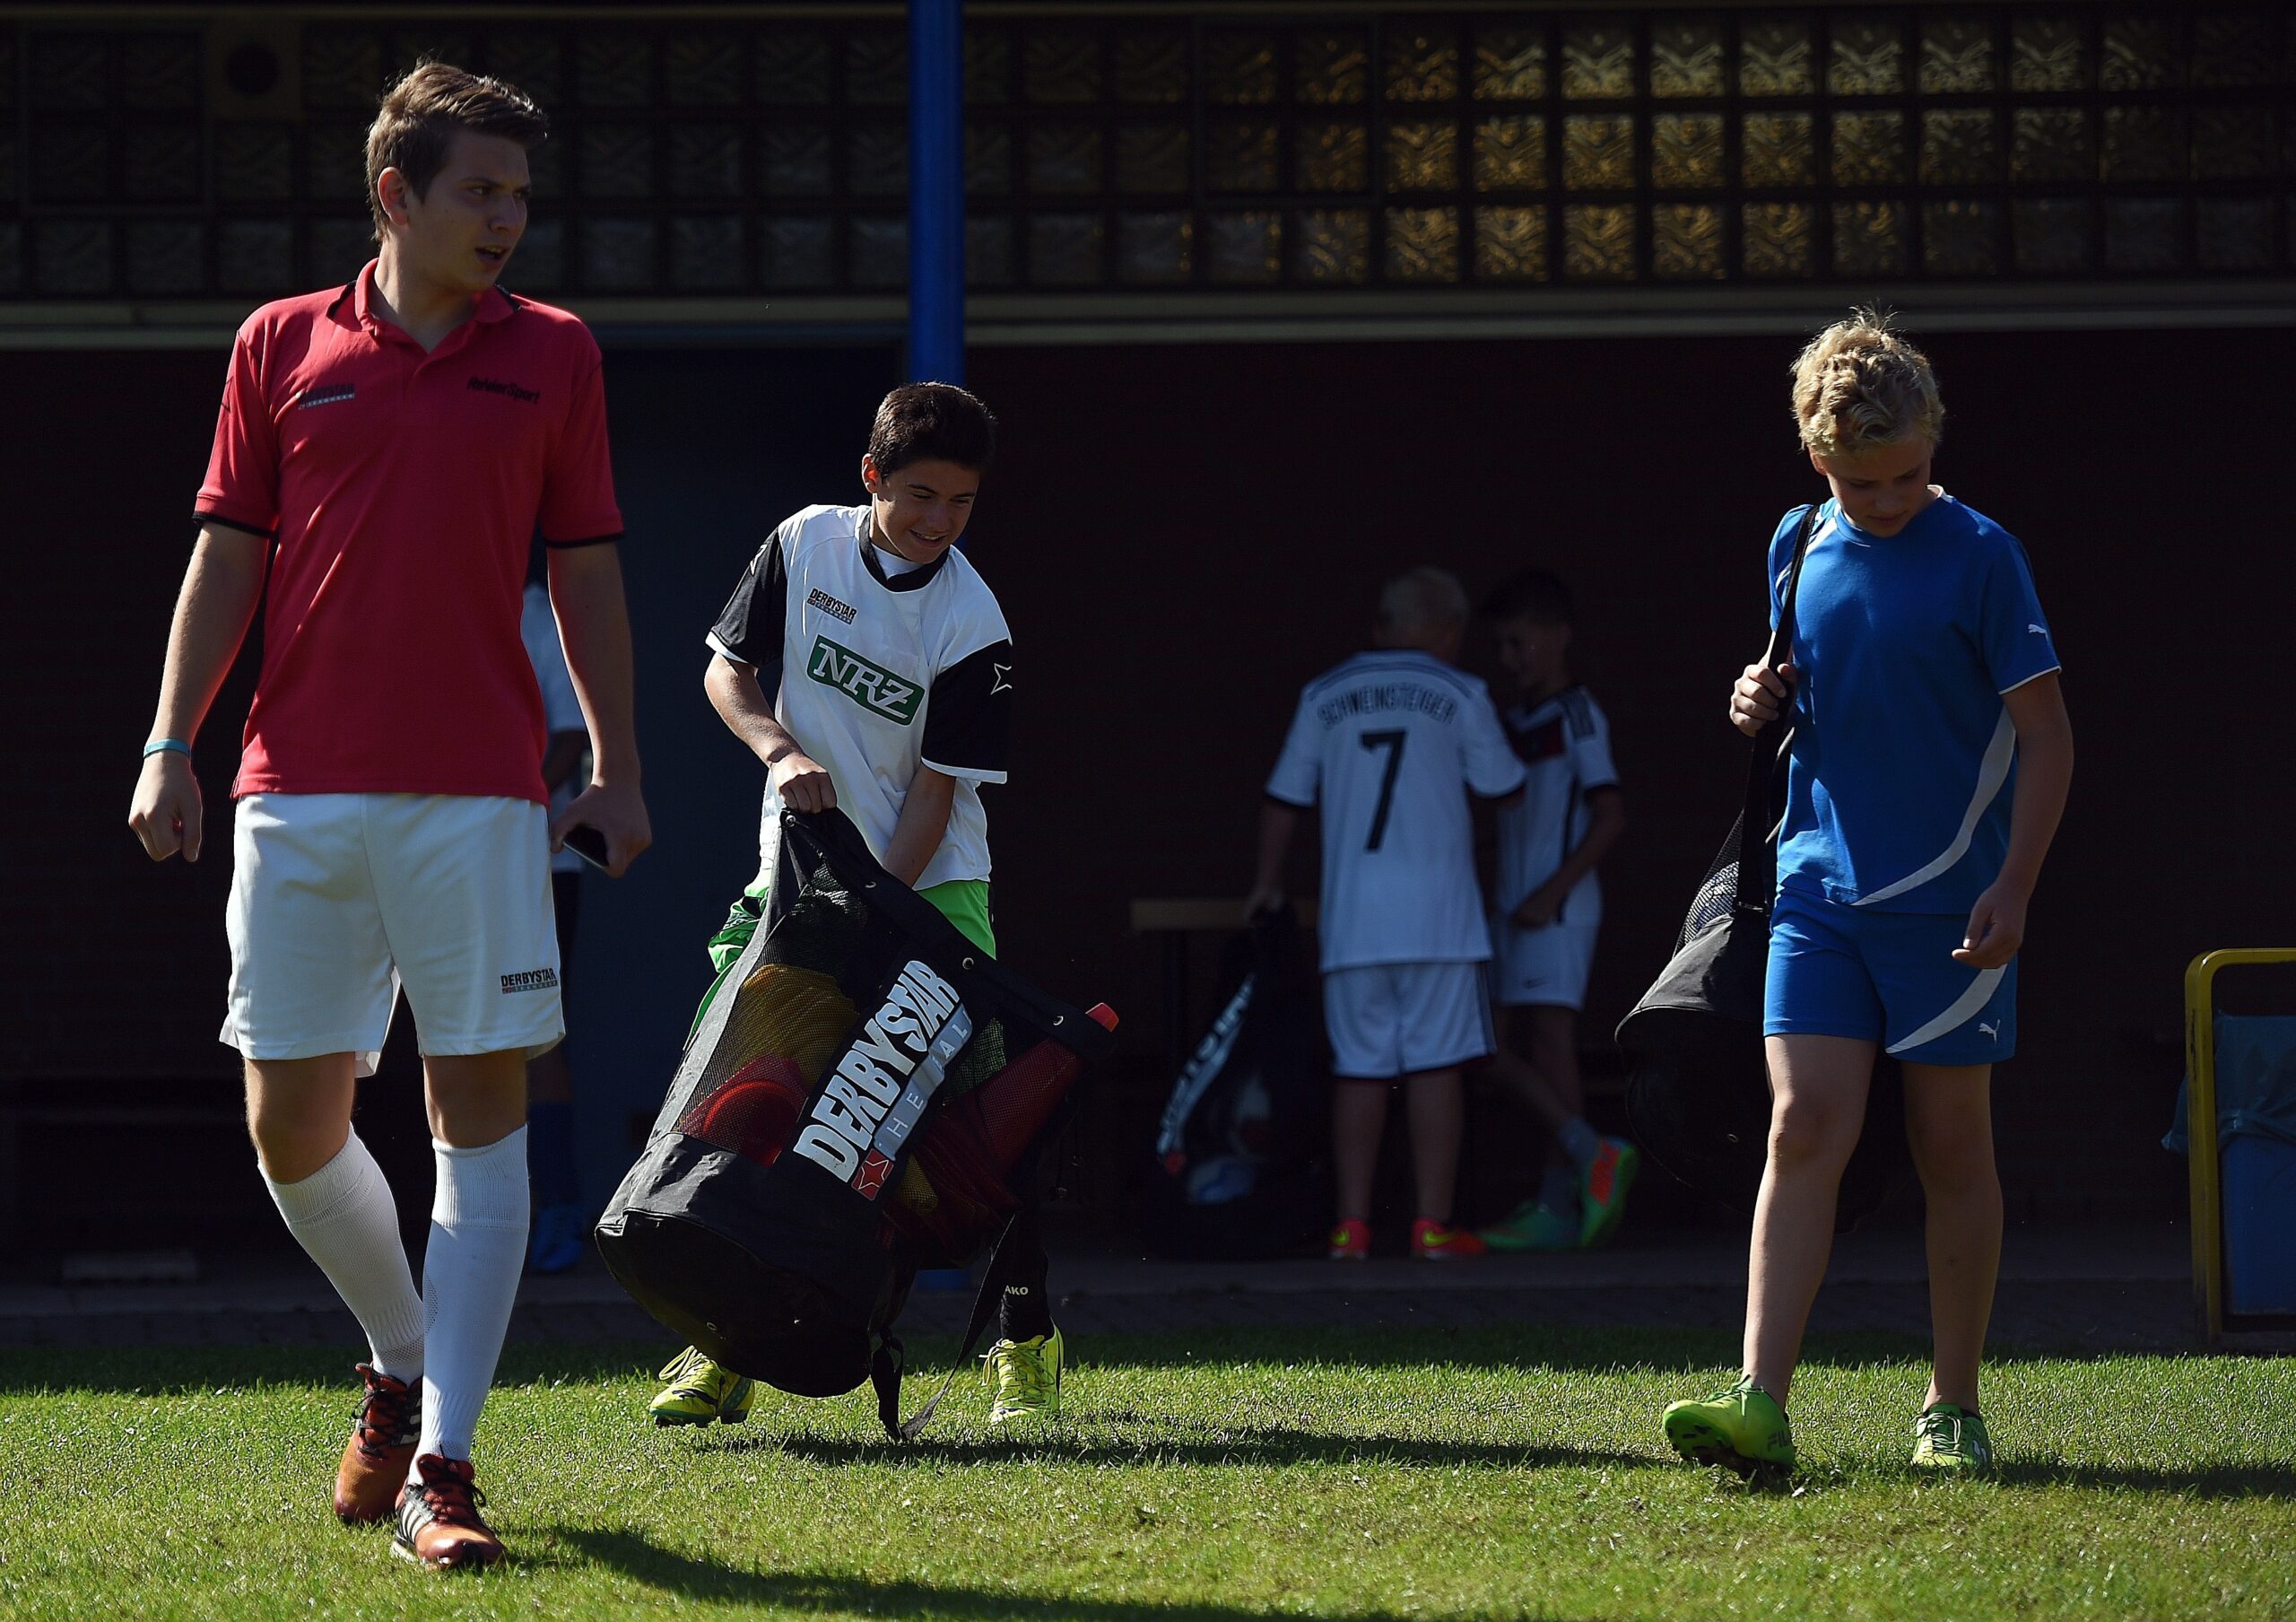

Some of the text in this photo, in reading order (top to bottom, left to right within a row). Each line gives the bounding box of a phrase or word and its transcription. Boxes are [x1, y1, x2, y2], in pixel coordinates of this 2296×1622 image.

[809, 588, 857, 620] DERBYSTAR
[813, 642, 915, 719] NRZ
[1361, 730, 1406, 850] 7
[500, 968, 556, 987] DERBYSTAR
[792, 959, 961, 1183] DERBYSTAR
[1004, 1285, 1029, 1296] AKO
